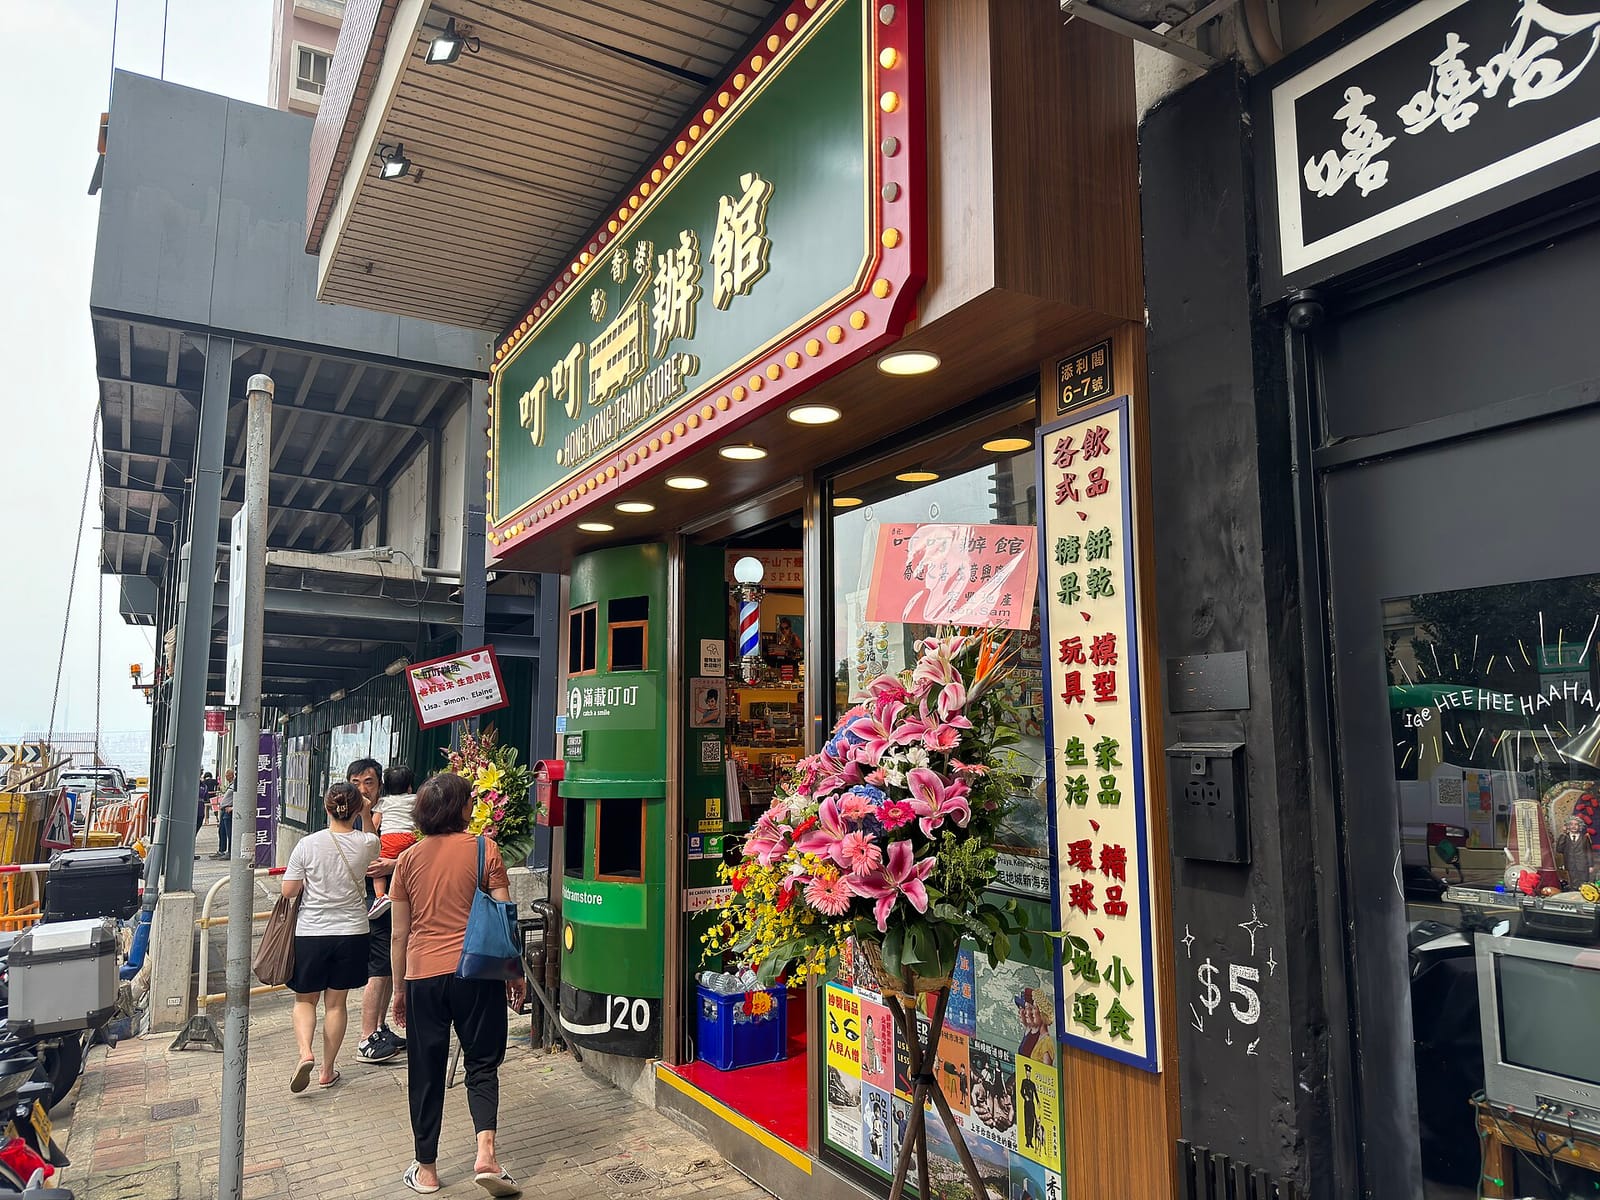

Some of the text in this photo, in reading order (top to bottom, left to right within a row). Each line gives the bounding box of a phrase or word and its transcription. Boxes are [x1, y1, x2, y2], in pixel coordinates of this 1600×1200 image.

[564, 352, 682, 467] HONG KONG TRAM STORE
[1198, 957, 1261, 1025] $5
